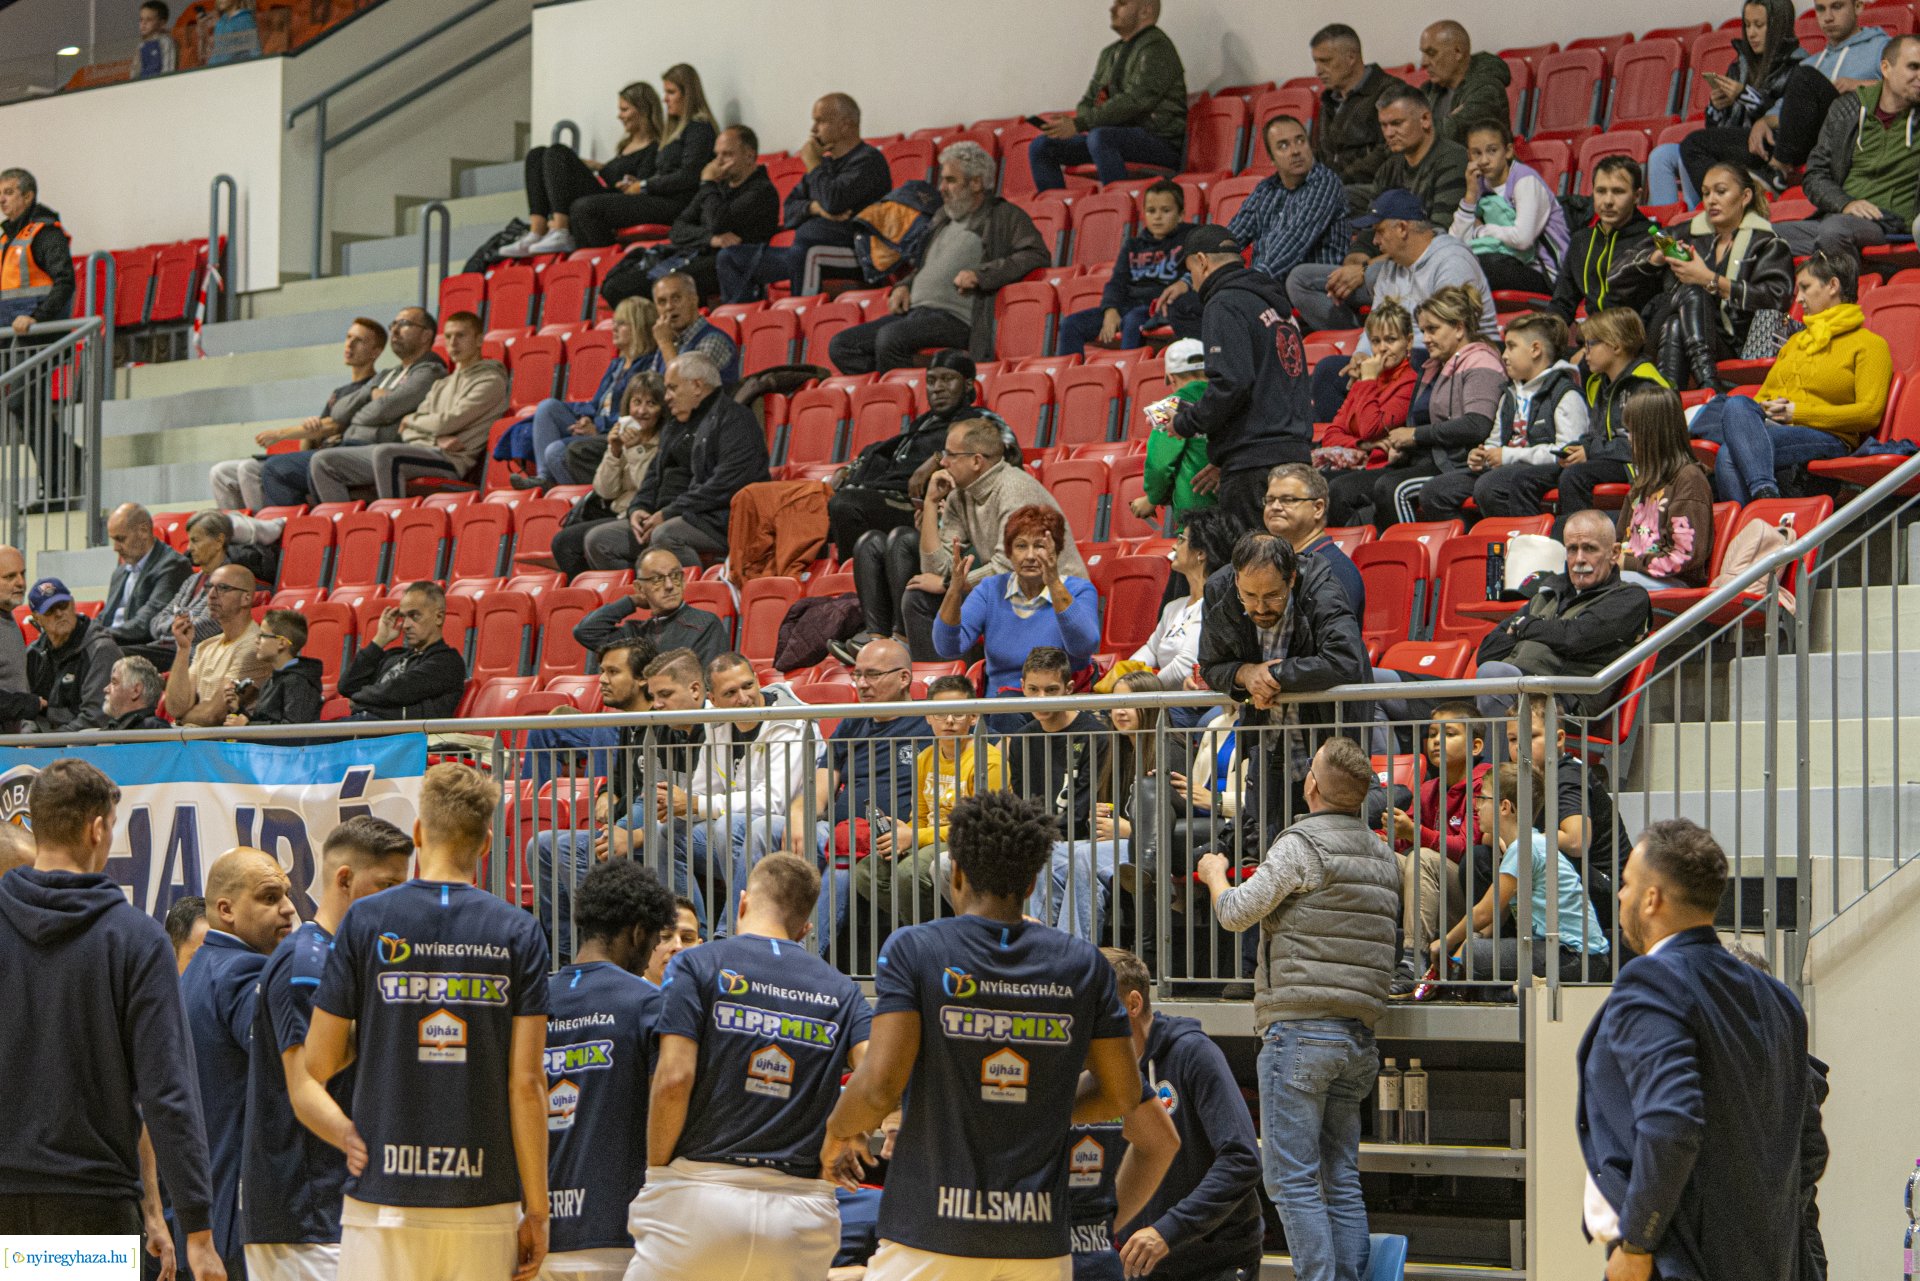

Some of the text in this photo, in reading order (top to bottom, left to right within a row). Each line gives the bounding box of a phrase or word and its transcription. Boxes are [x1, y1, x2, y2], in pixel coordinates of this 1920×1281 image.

[414, 942, 511, 959] NYÍREGYHÁZA
[751, 981, 840, 1007] NYÍREGYHÁZA
[980, 980, 1073, 998] NYÍREGYHÁZA
[384, 1144, 484, 1177] DOLEZAJ
[937, 1185, 1052, 1222] HILLSMAN
